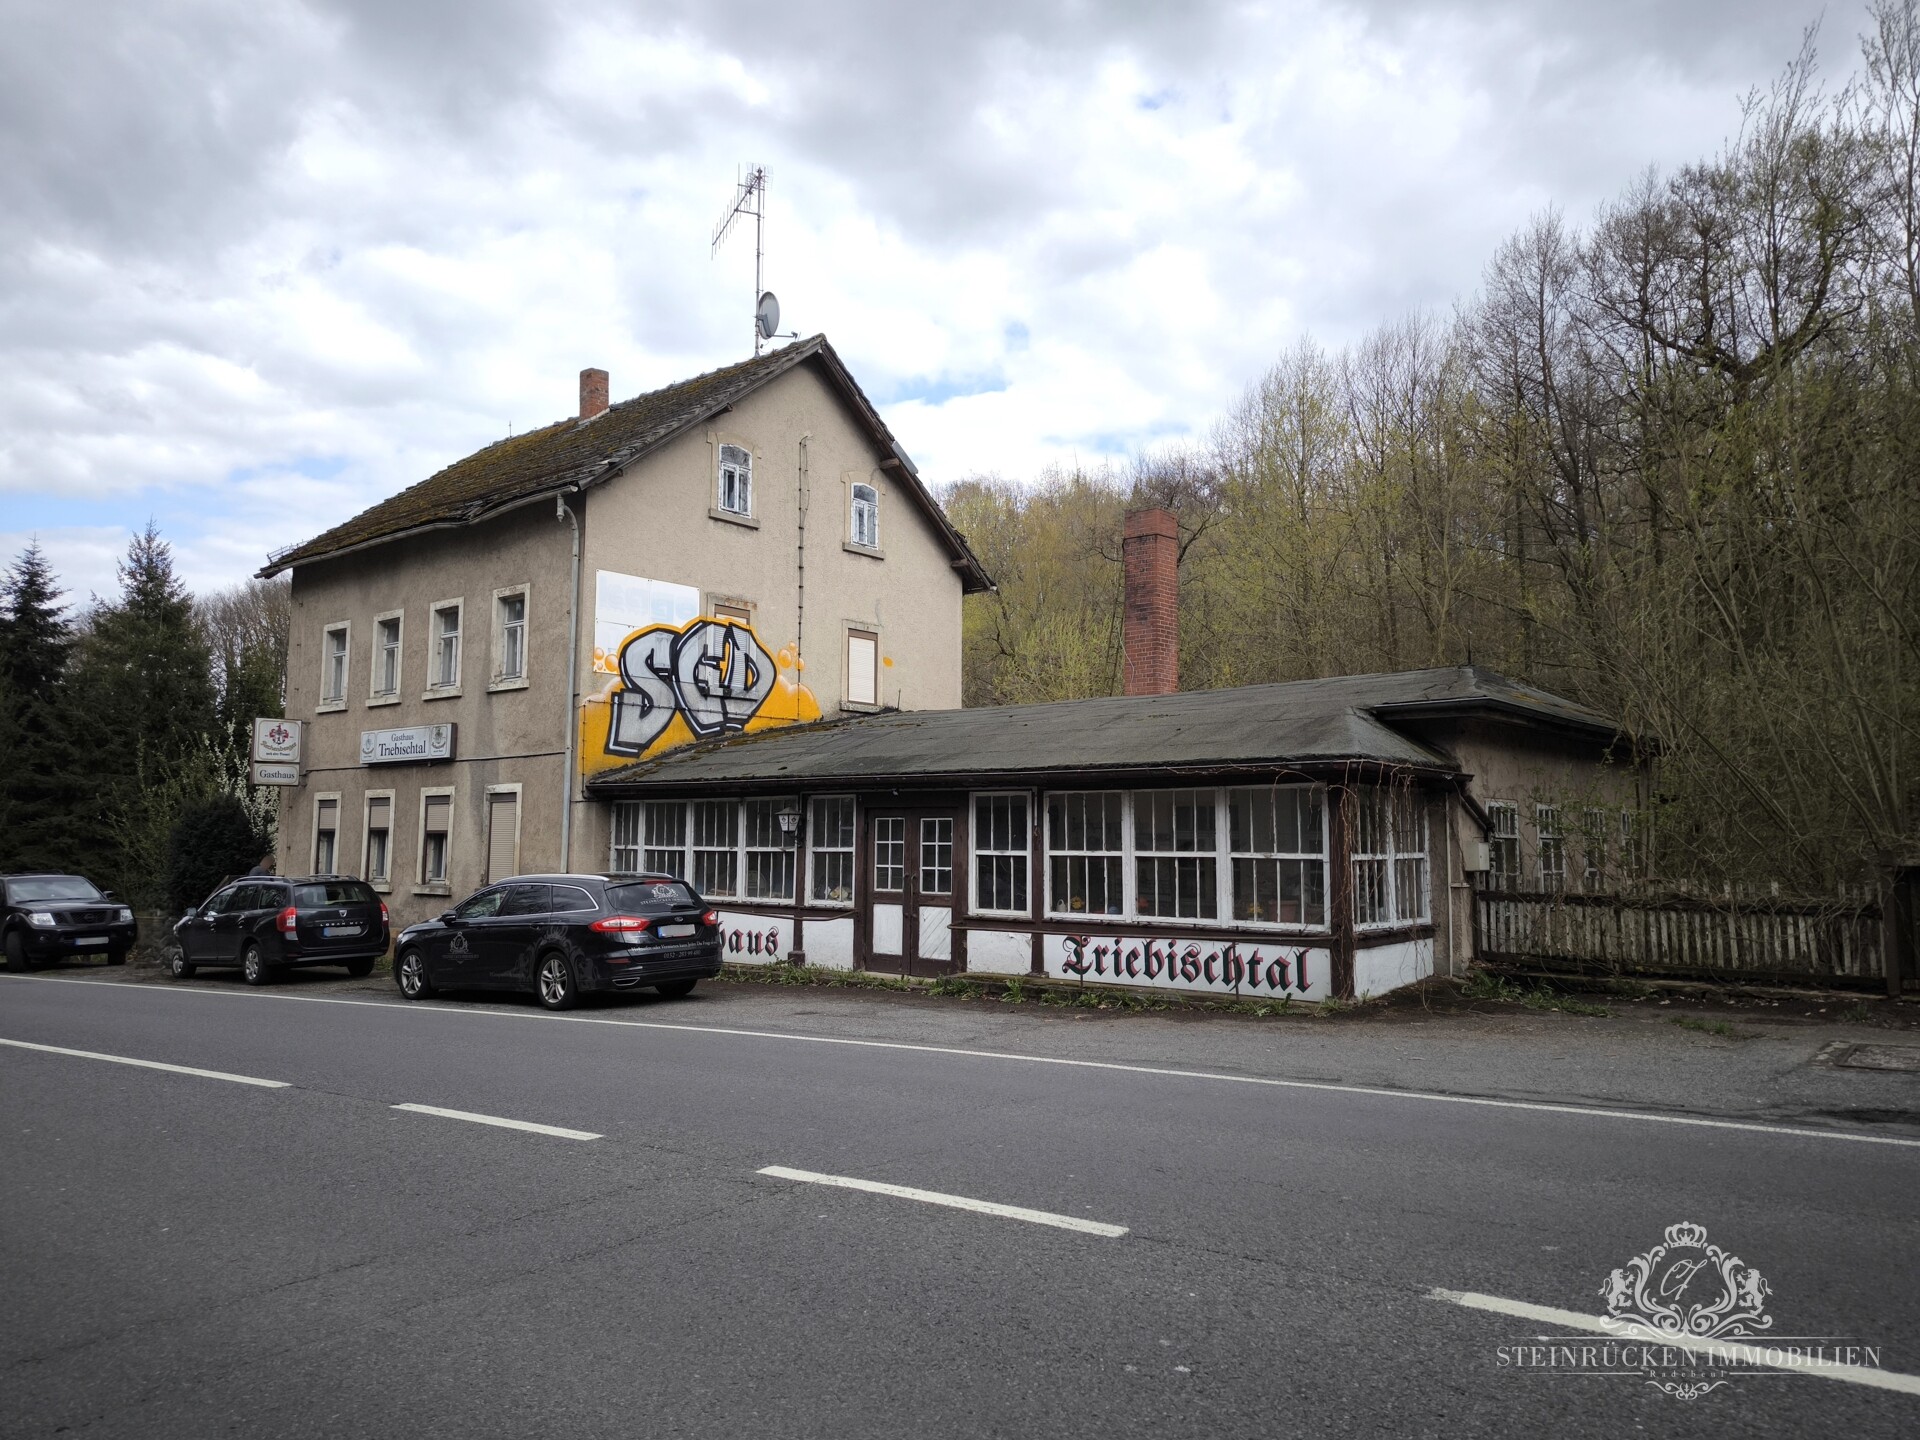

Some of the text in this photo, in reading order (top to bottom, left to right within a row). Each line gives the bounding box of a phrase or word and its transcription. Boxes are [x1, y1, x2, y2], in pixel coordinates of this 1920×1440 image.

[391, 732, 415, 742] Gasthaus
[378, 740, 426, 757] Triebischtal
[259, 769, 295, 779] Gasthaus
[1062, 935, 1313, 993] Triebischtal
